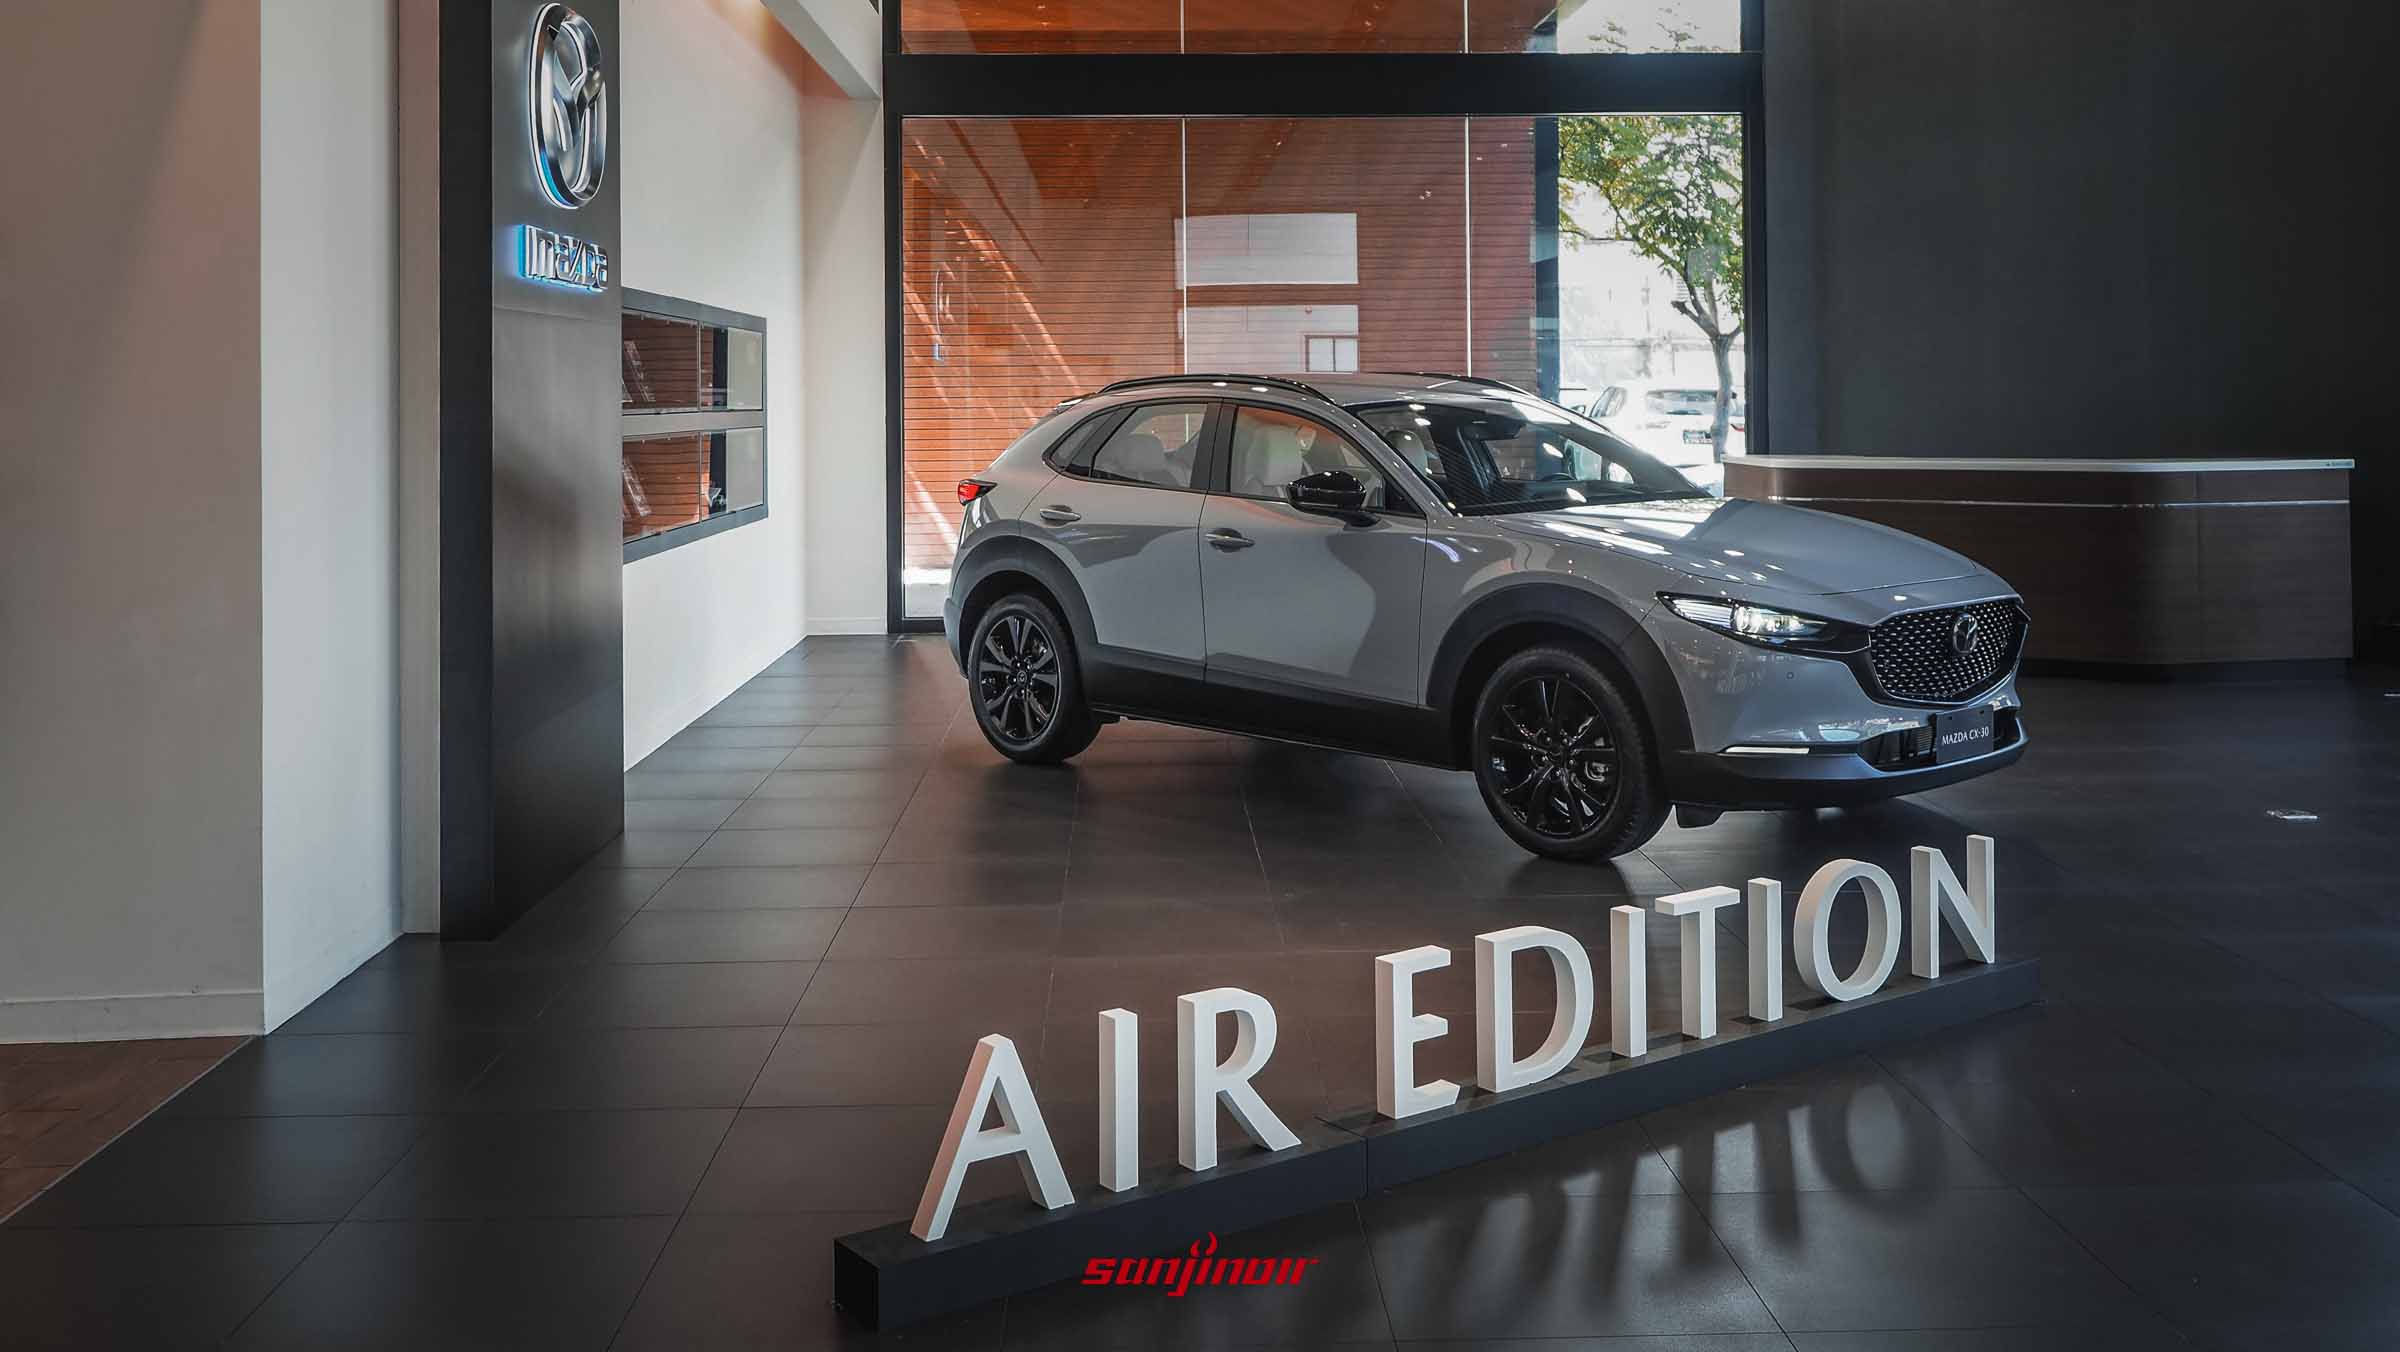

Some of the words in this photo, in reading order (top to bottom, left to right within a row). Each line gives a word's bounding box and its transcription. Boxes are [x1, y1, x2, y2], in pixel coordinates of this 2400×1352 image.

[520, 224, 609, 292] mazda
[1941, 731, 1968, 745] MAZDA
[1969, 726, 1990, 740] CX-30
[910, 987, 1302, 1242] AIR
[1375, 834, 1995, 1120] EDITION
